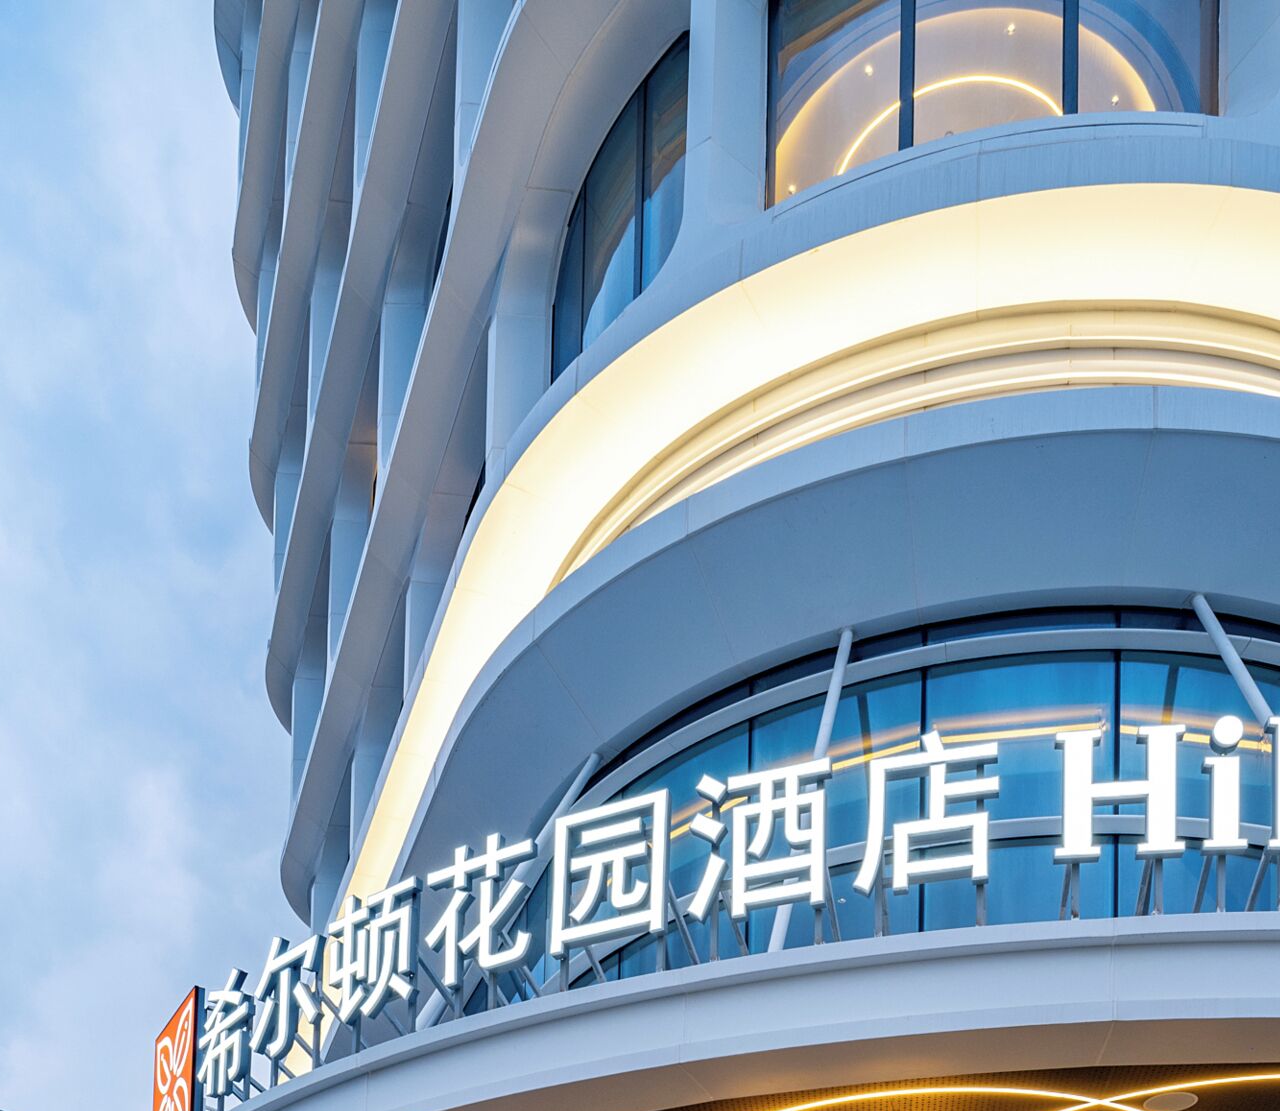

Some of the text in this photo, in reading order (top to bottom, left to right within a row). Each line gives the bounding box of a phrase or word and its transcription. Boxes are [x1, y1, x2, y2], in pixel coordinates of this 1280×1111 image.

[197, 731, 1001, 1097] 希尔顿花园酒店
